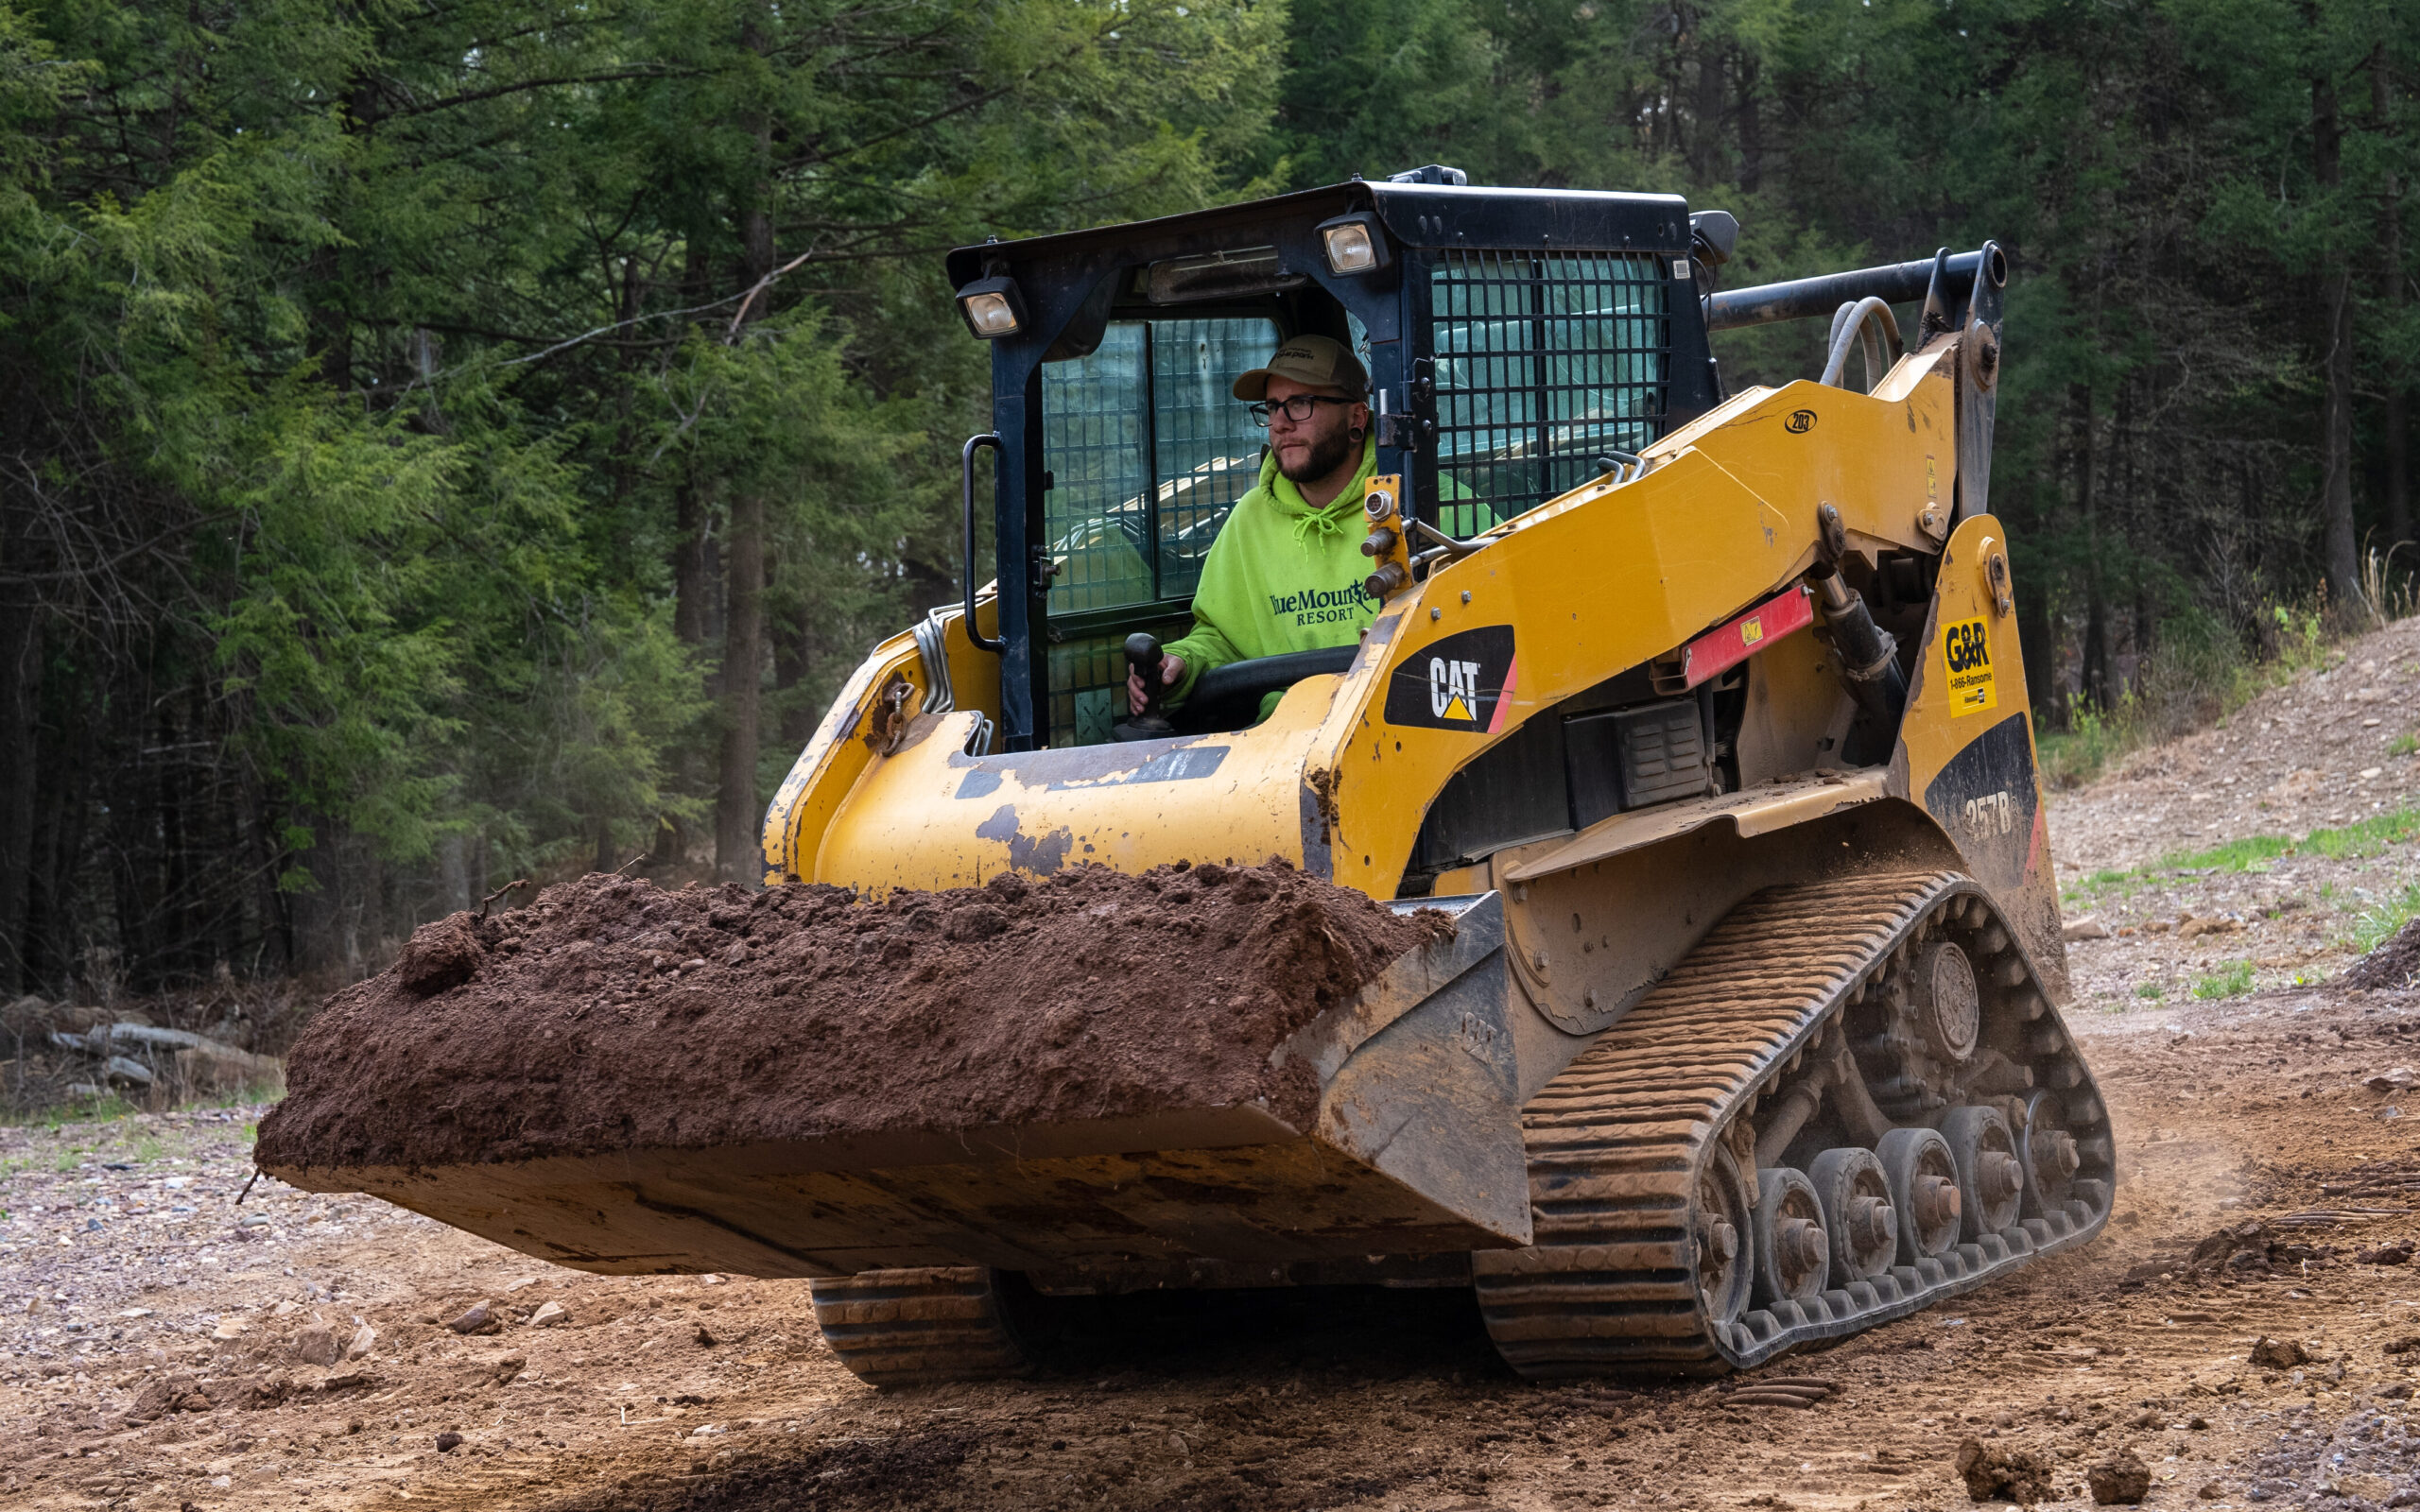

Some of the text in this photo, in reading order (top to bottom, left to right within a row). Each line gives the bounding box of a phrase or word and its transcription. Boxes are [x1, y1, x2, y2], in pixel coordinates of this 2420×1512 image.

[1792, 413, 1809, 431] 203
[1297, 608, 1354, 627] RESORT
[1946, 622, 1990, 673] G&R
[1429, 657, 1478, 721] CAT
